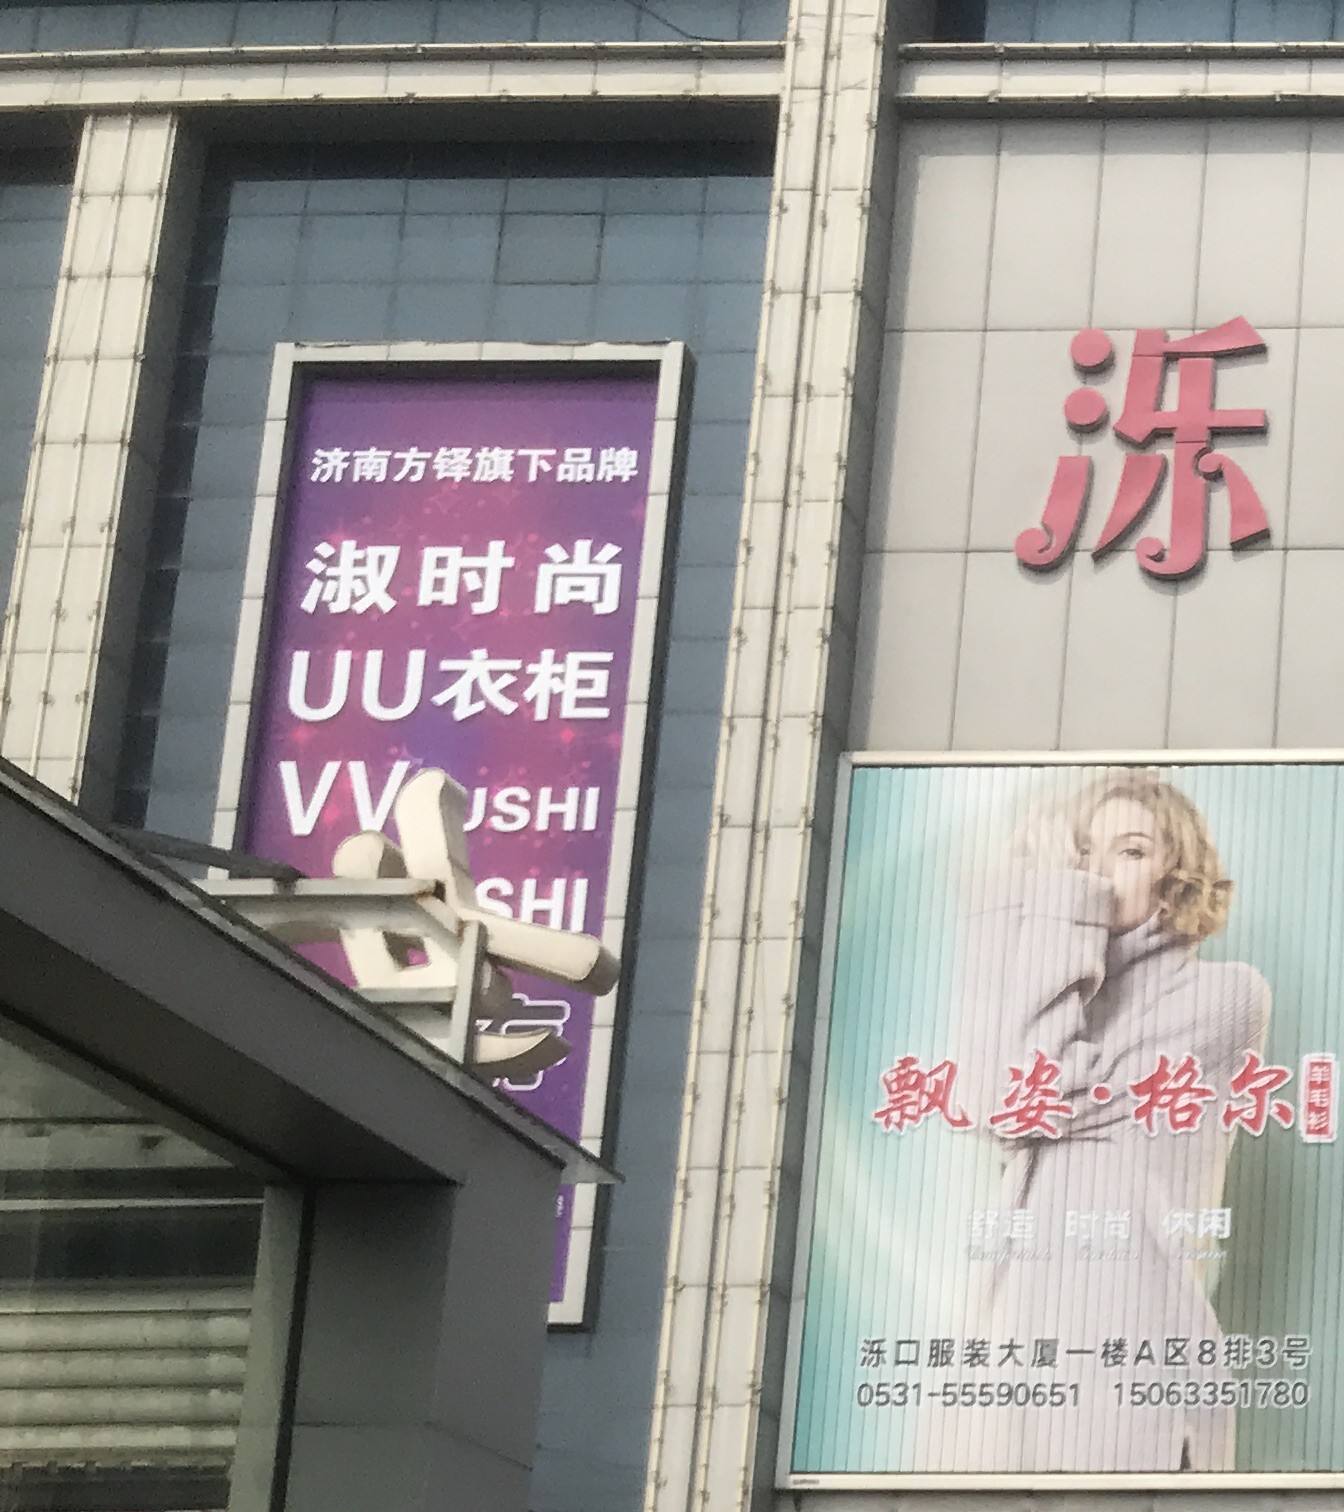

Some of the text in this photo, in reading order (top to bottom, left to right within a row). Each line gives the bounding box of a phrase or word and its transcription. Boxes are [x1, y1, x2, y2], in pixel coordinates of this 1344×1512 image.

[300, 539, 624, 616] 淑时尚
[287, 648, 615, 722] UU衣柜
[856, 1381, 1309, 1408] 0531-55590651 15063351780
